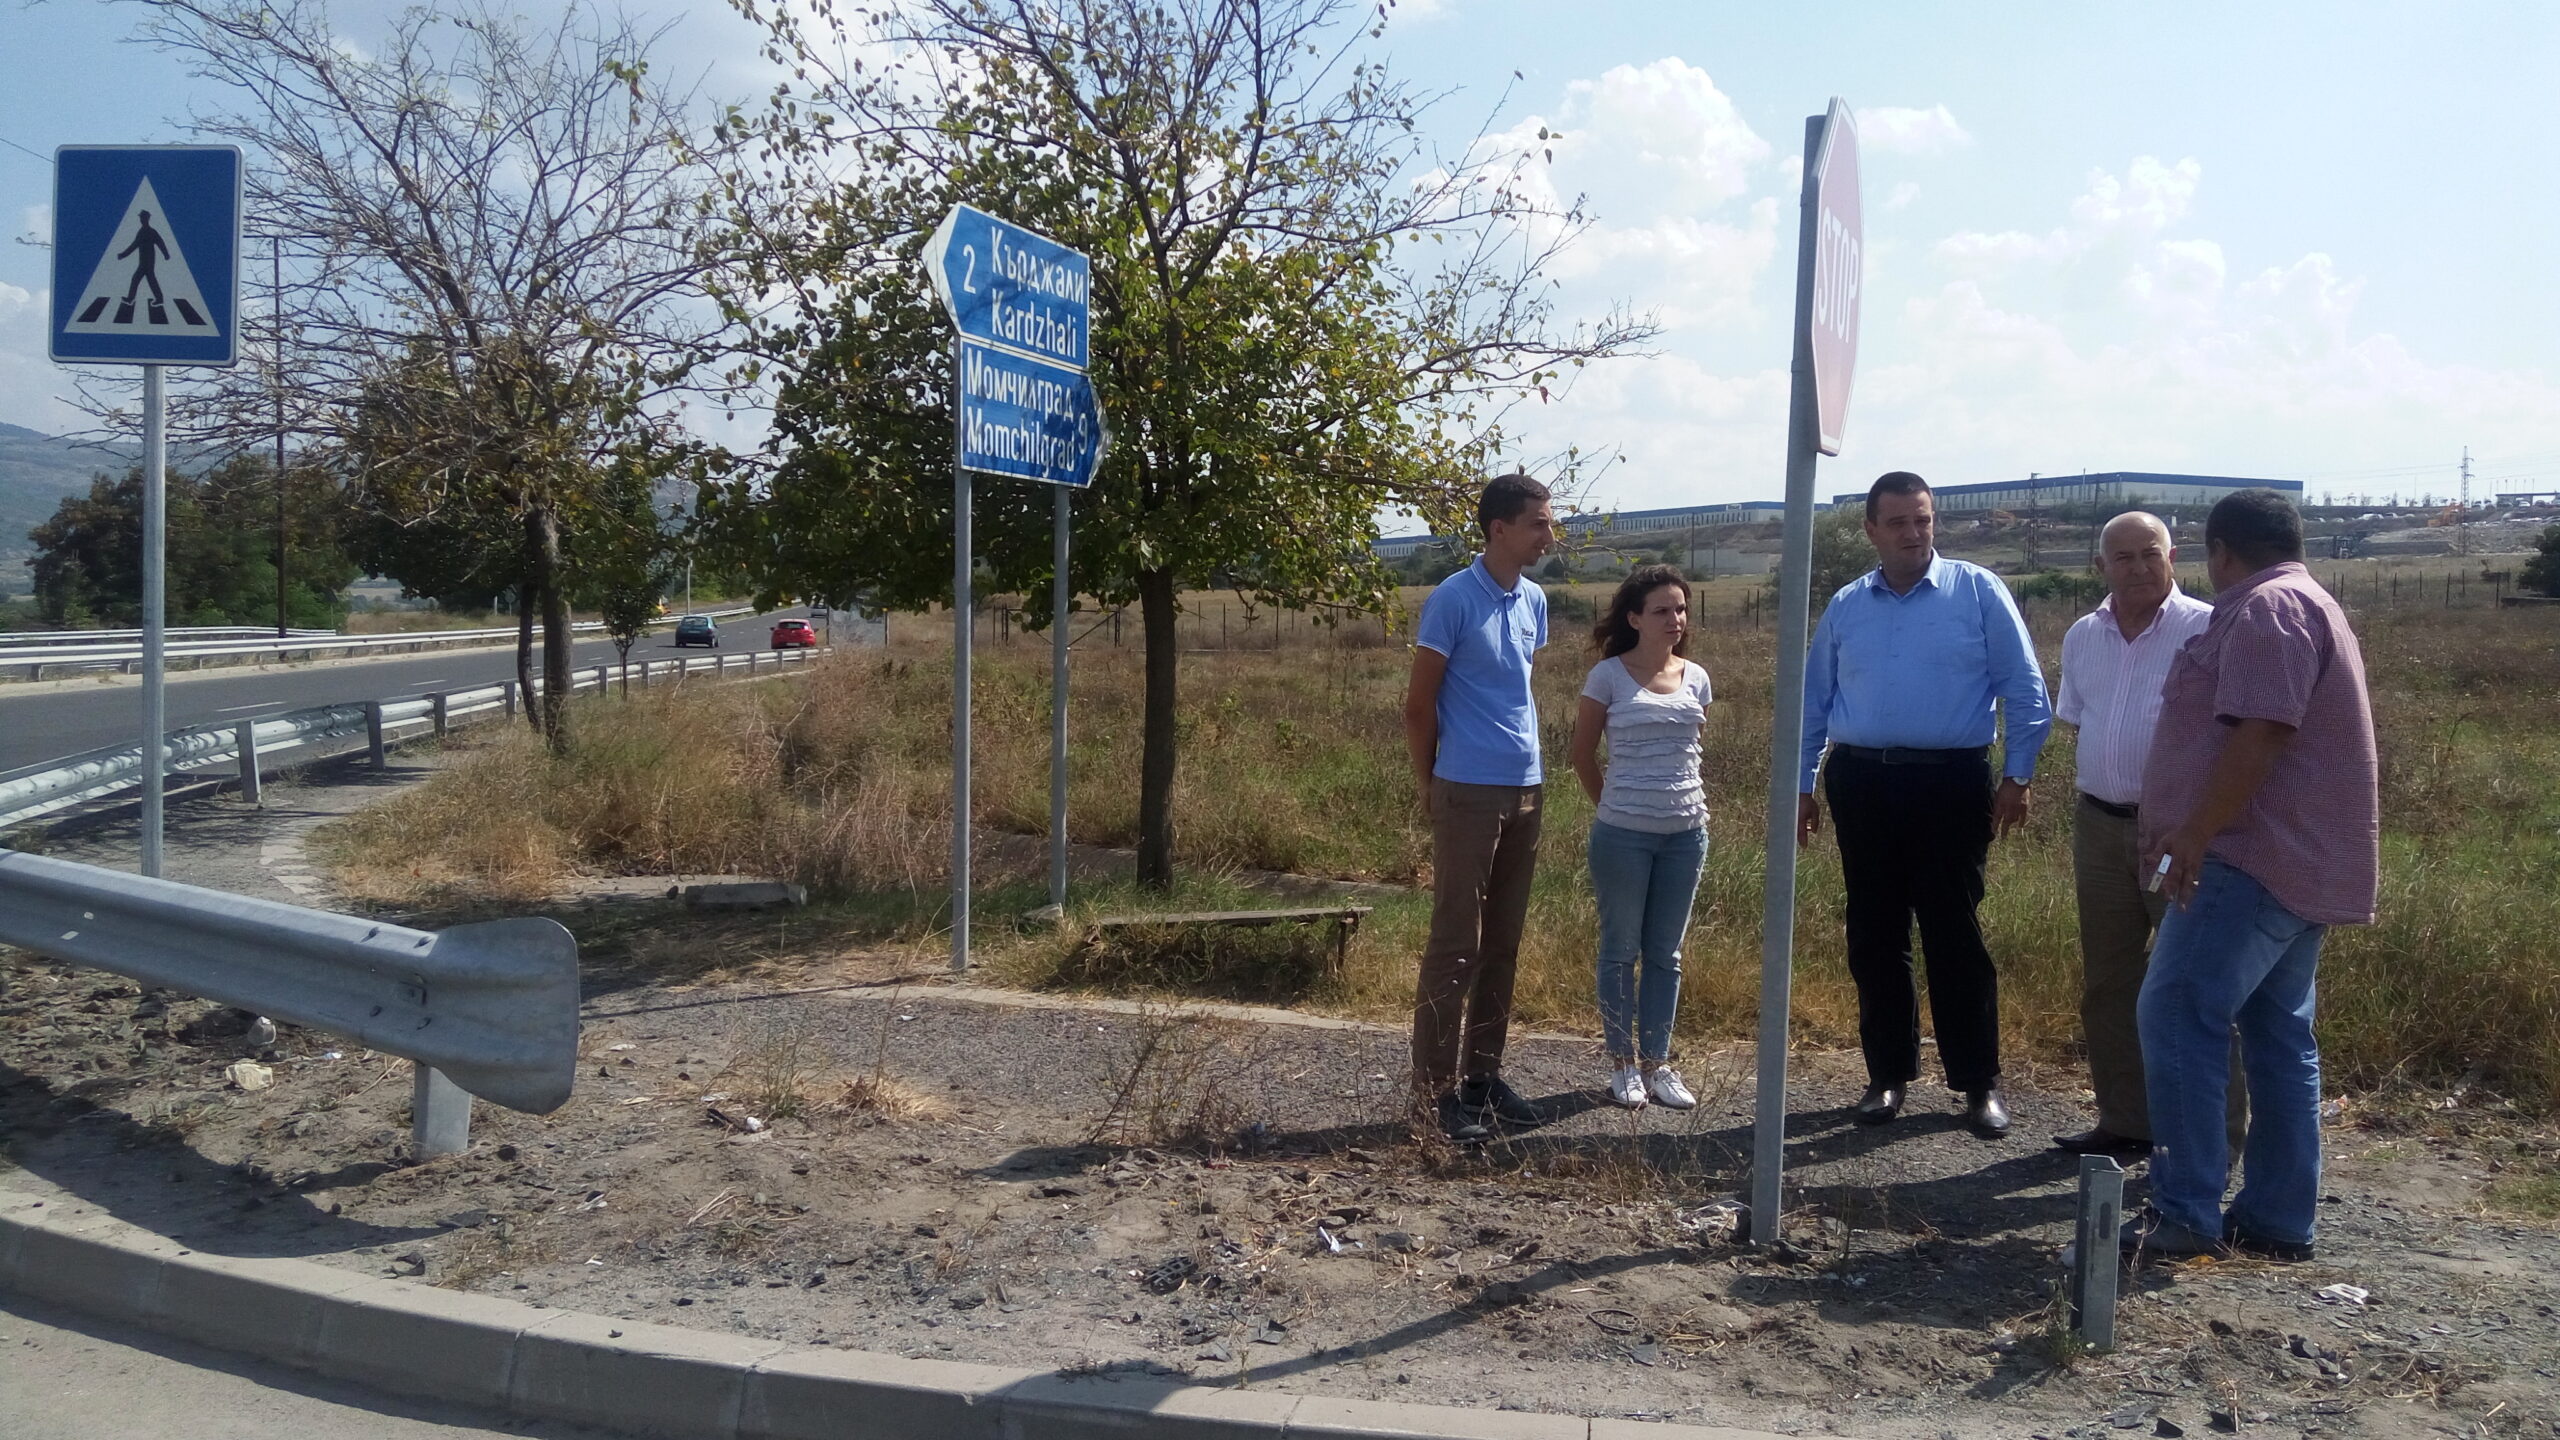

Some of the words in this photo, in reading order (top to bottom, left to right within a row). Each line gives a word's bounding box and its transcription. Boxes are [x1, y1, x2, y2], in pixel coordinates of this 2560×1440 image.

[962, 244, 976, 294] 2
[991, 226, 1084, 305] Кърджали
[1818, 206, 1859, 343] STOP
[991, 288, 1077, 358] Kardzhali
[966, 348, 1074, 425] Момчилград
[966, 406, 1075, 478] Momchilgrad
